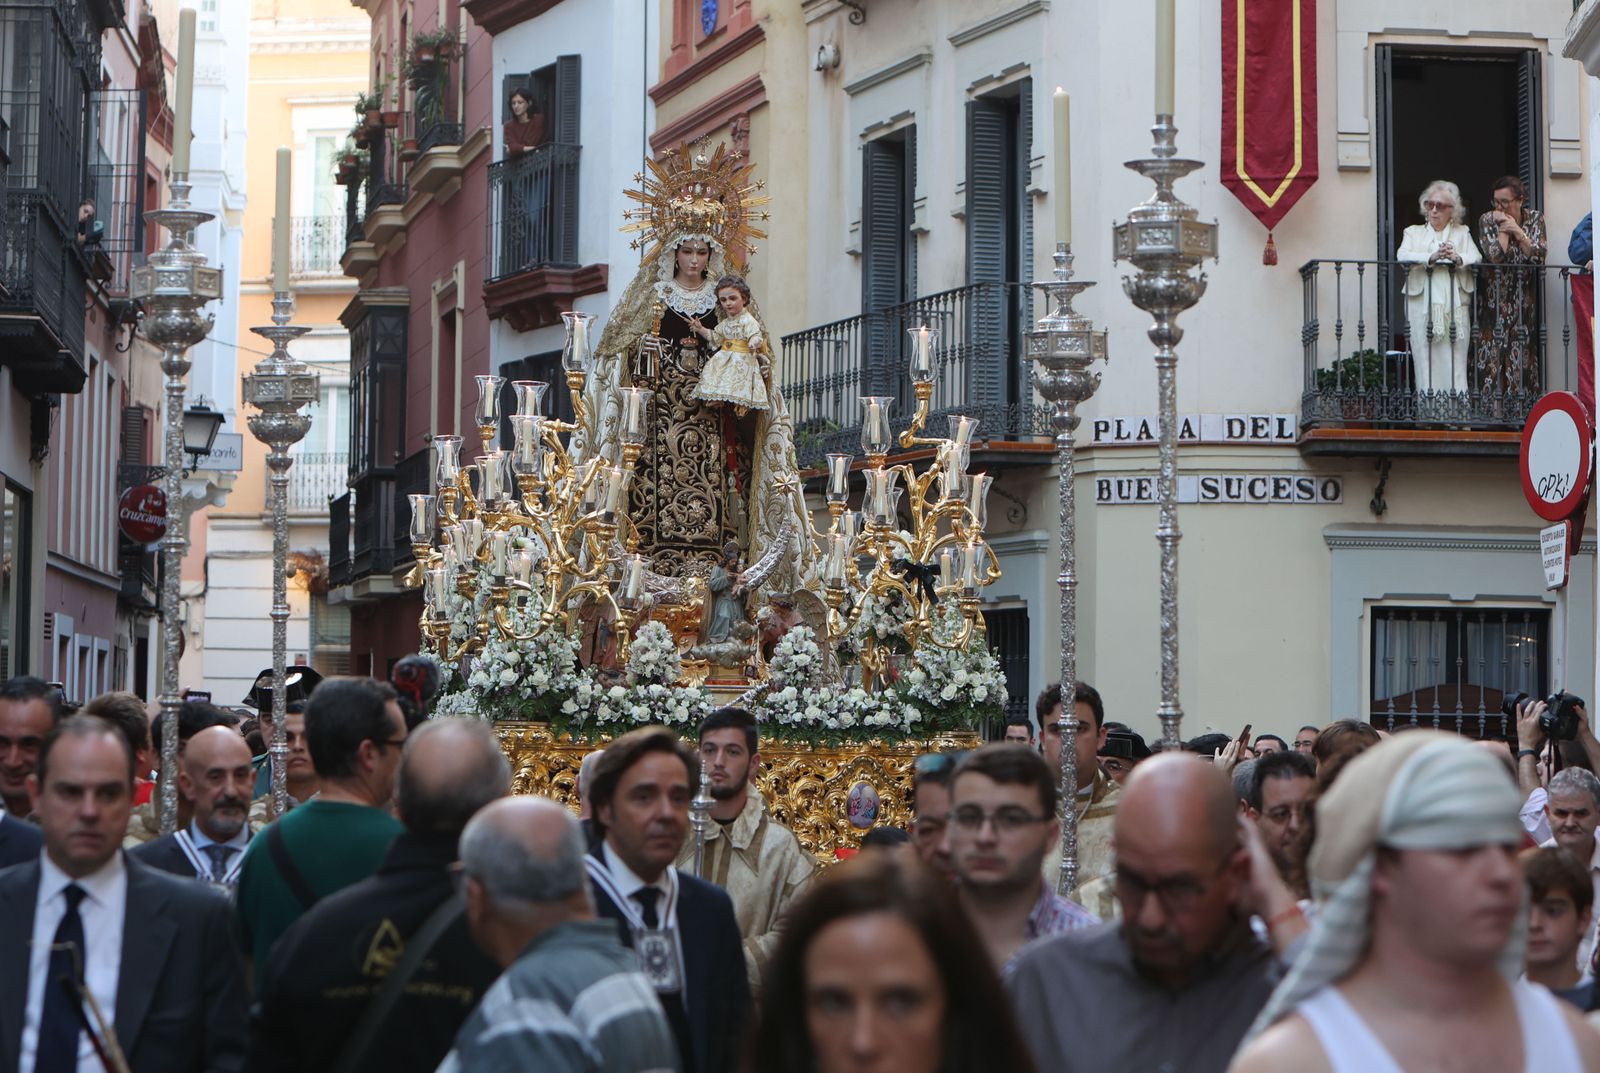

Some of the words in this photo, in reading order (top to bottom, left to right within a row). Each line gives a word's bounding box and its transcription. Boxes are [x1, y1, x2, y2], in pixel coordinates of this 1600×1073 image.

[1094, 417, 1197, 441] PLAA
[1226, 417, 1294, 440] DEL
[1096, 478, 1172, 501] BUE
[1201, 477, 1341, 501] SUCESO
